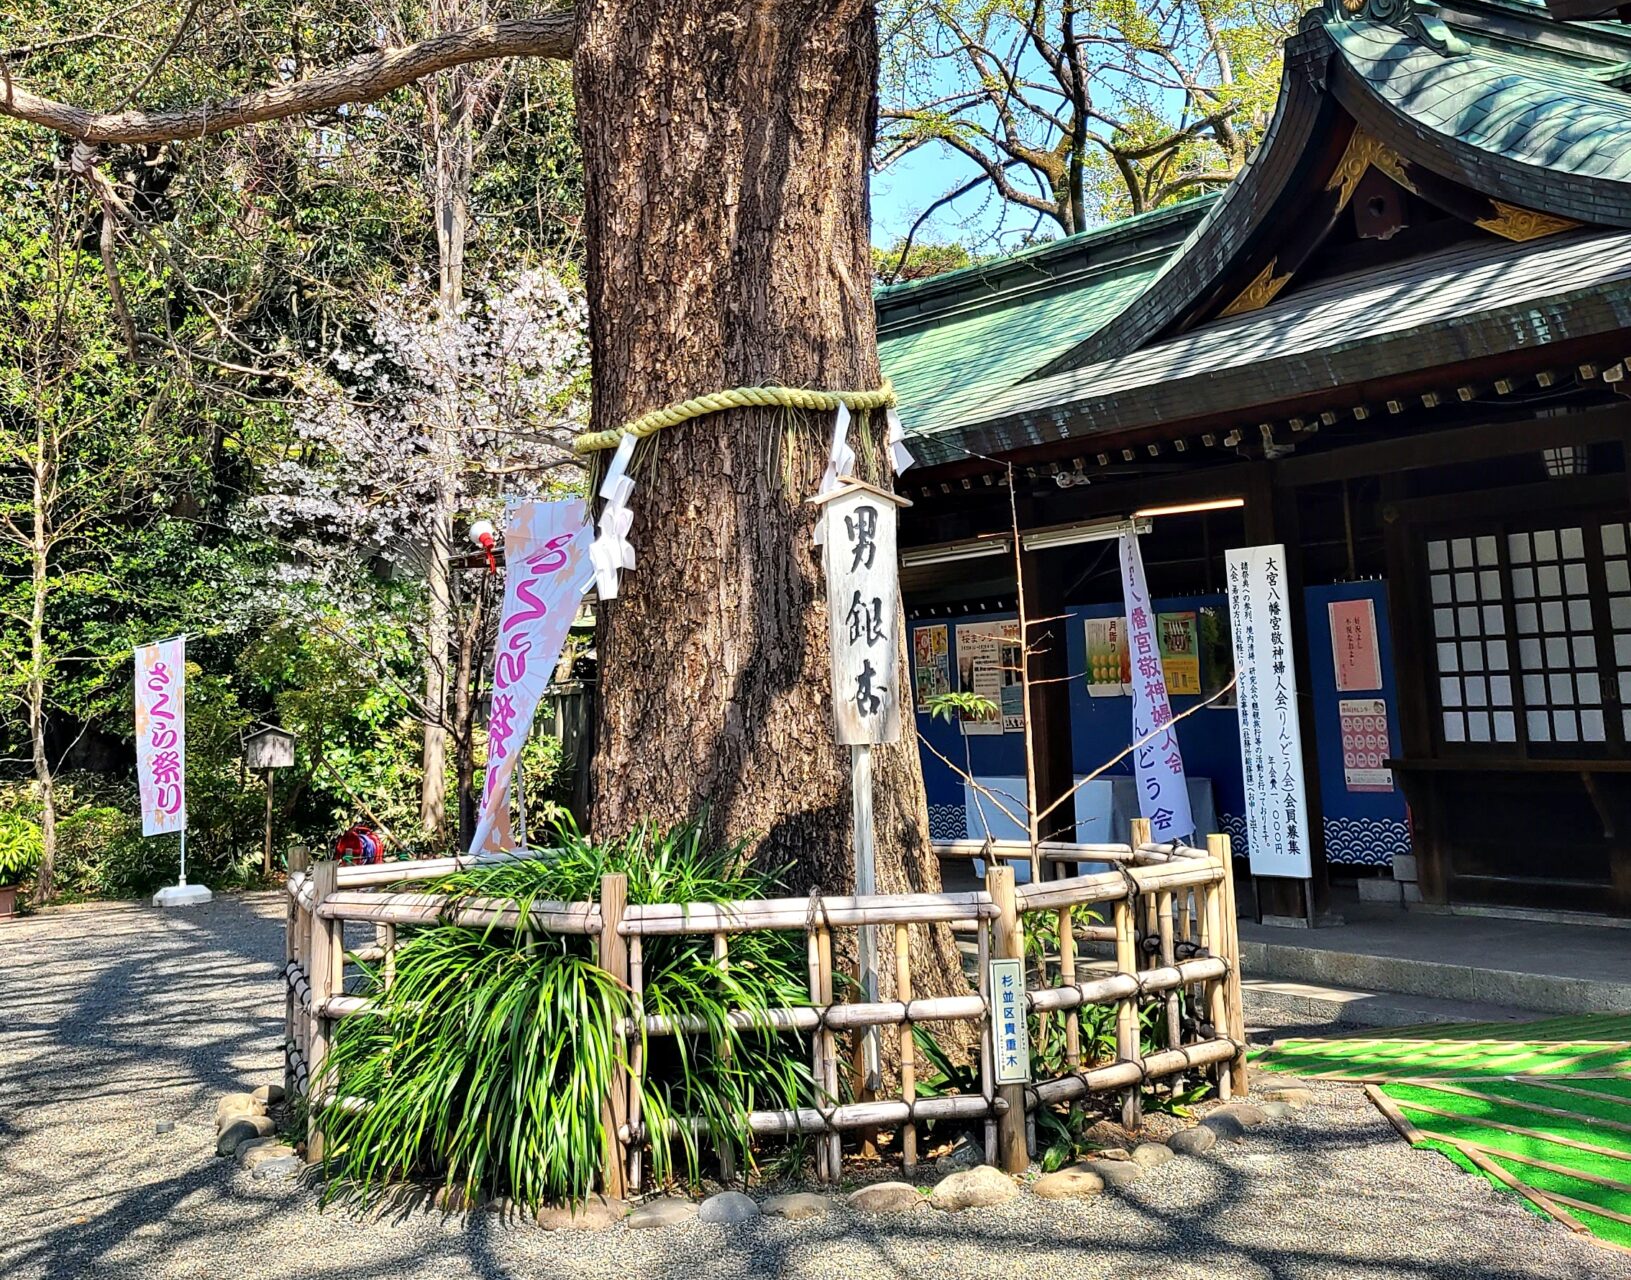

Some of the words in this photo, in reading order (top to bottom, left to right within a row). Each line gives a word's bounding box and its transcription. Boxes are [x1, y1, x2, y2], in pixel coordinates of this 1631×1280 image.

[844, 505, 888, 717] 男銀杏
[148, 662, 182, 815] さくら祭り
[1002, 975, 1018, 1067] 杉並区貴重木
